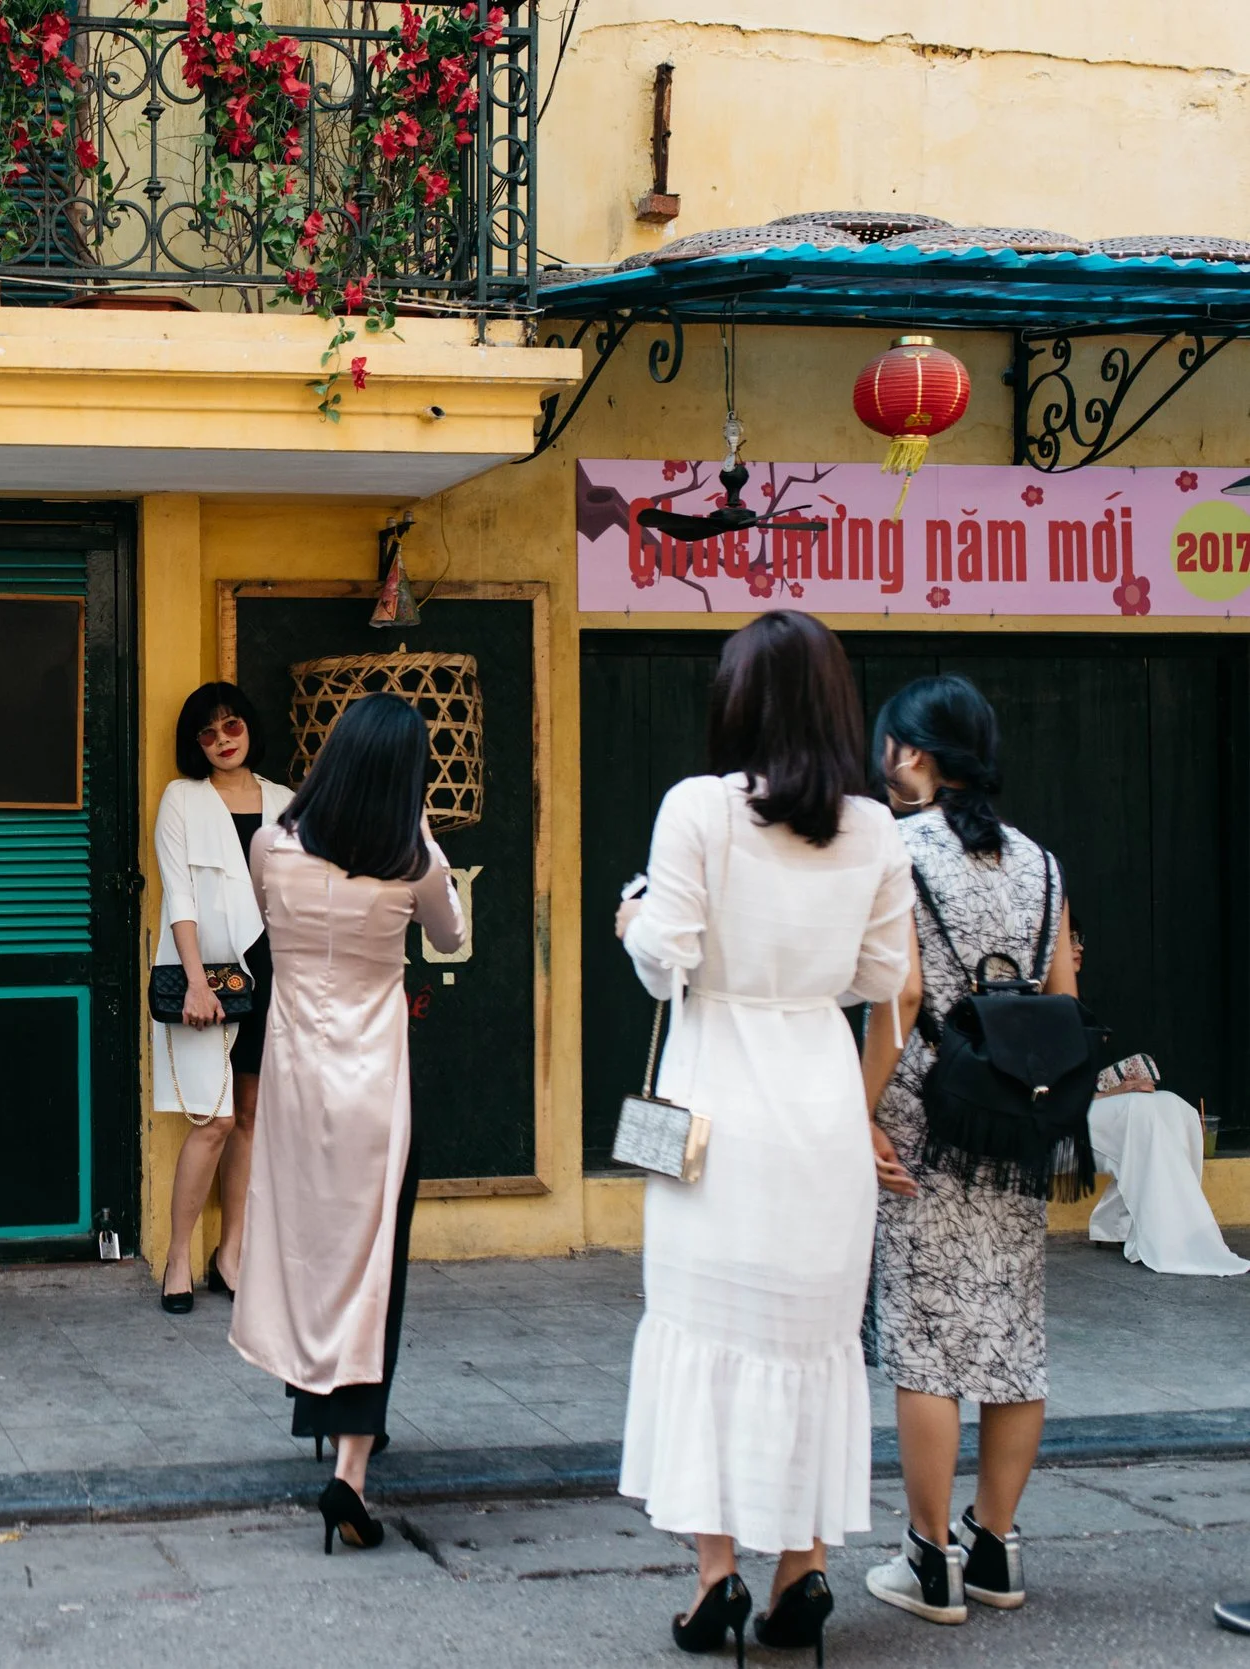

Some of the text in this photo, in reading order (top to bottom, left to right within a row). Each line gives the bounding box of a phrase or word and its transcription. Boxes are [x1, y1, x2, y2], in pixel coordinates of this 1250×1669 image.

[628, 491, 1250, 594] Chúc mừng năm mới 2017
